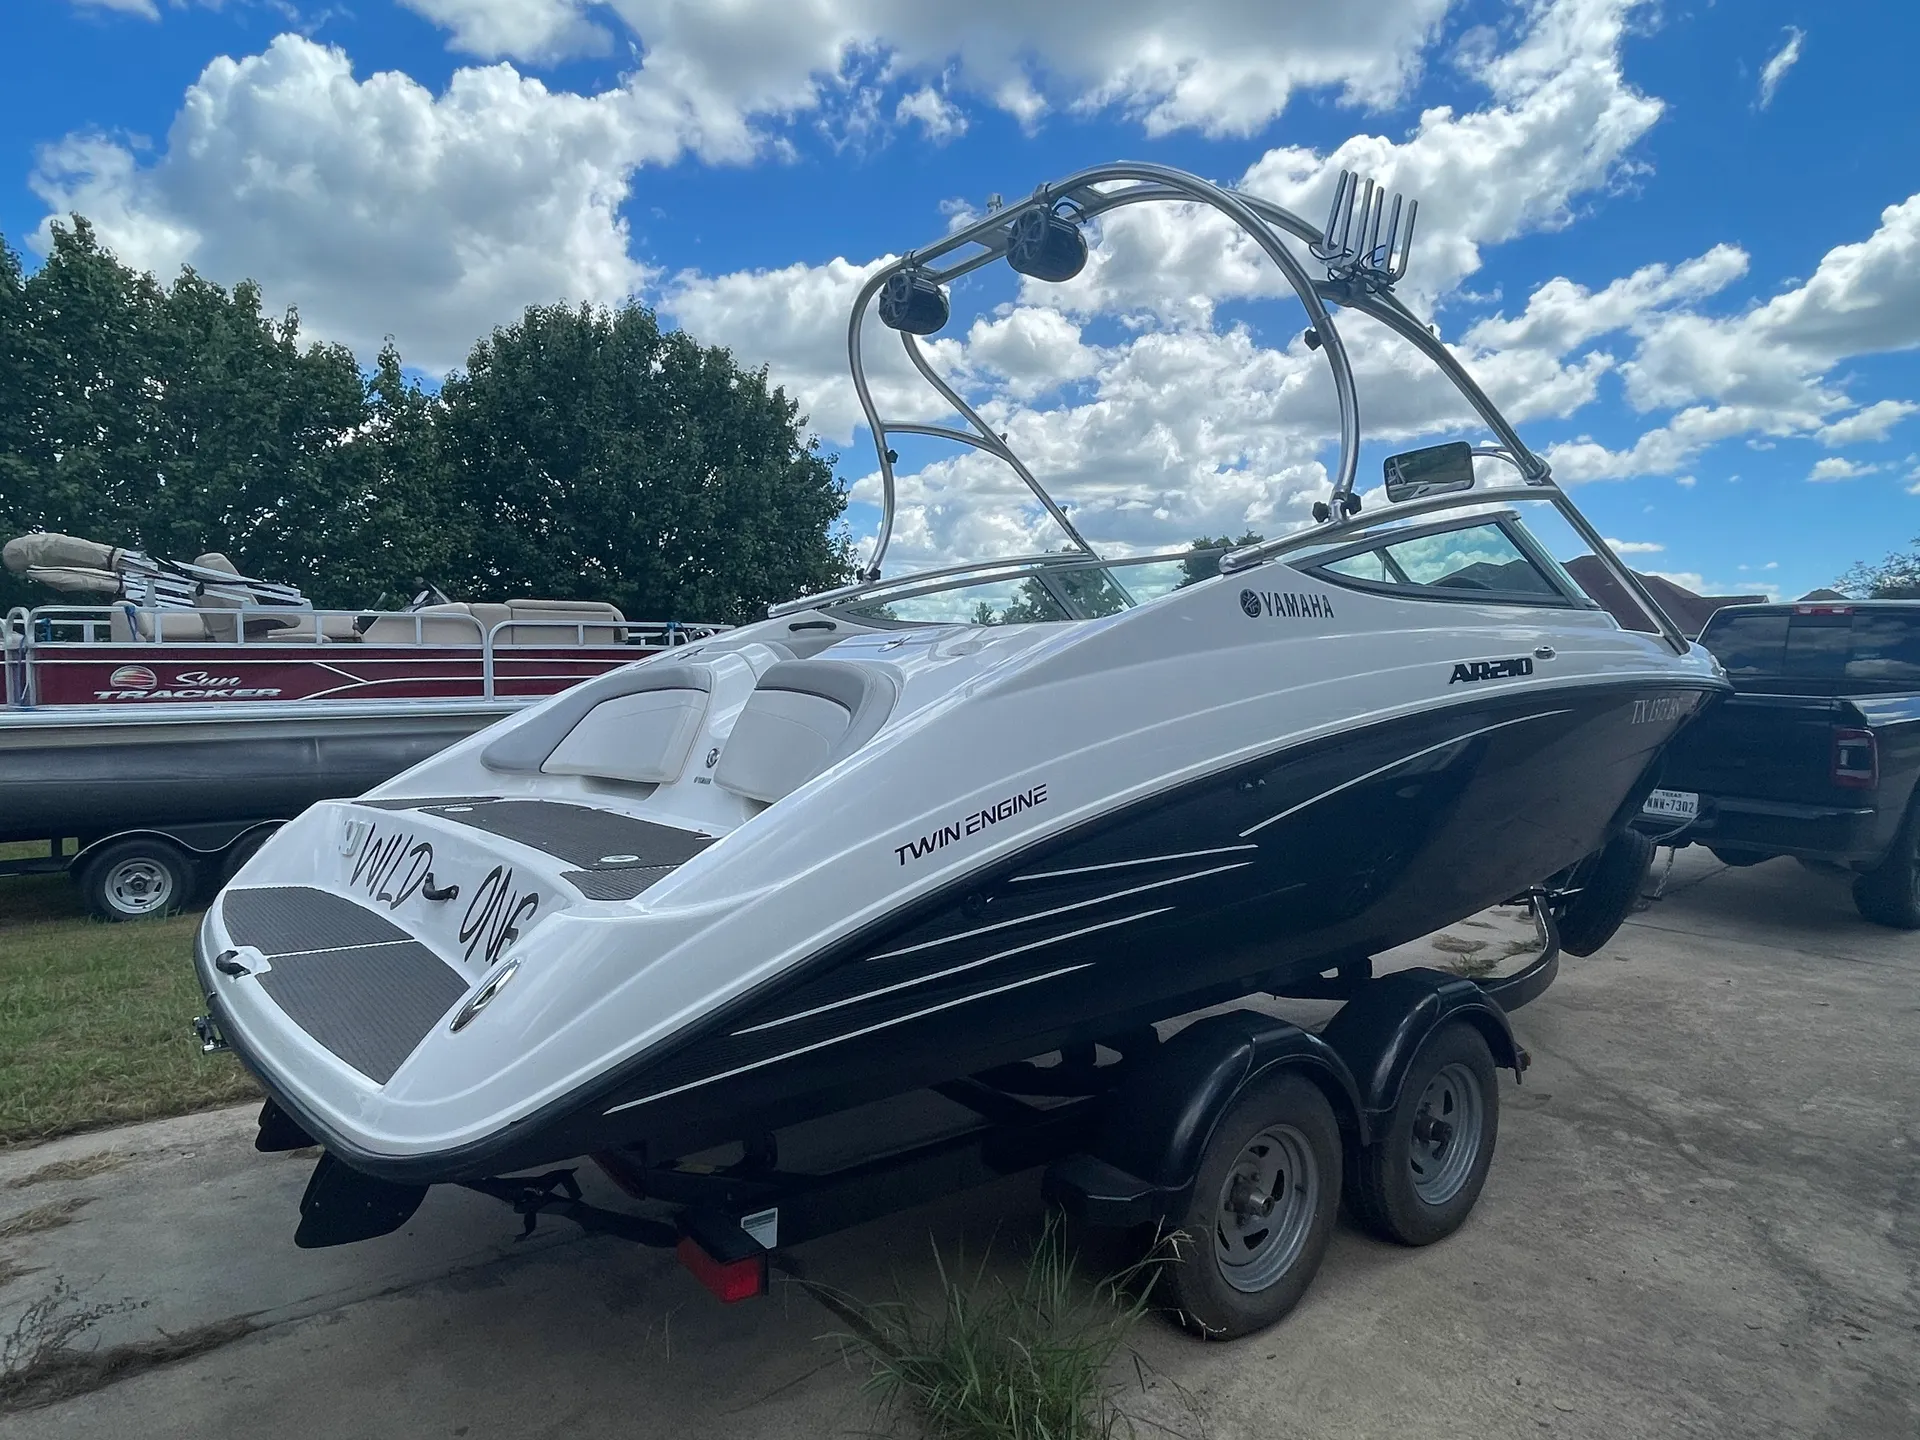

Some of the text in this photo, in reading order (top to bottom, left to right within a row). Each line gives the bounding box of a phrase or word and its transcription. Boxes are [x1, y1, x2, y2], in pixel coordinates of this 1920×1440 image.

[1260, 591, 1334, 618] YAMAHA
[165, 671, 242, 687] Sun
[1449, 658, 1533, 684] AR210
[93, 688, 282, 700] TRACKER
[895, 783, 1047, 866] TWIN ENGINE
[350, 822, 539, 966] WILD ONE
